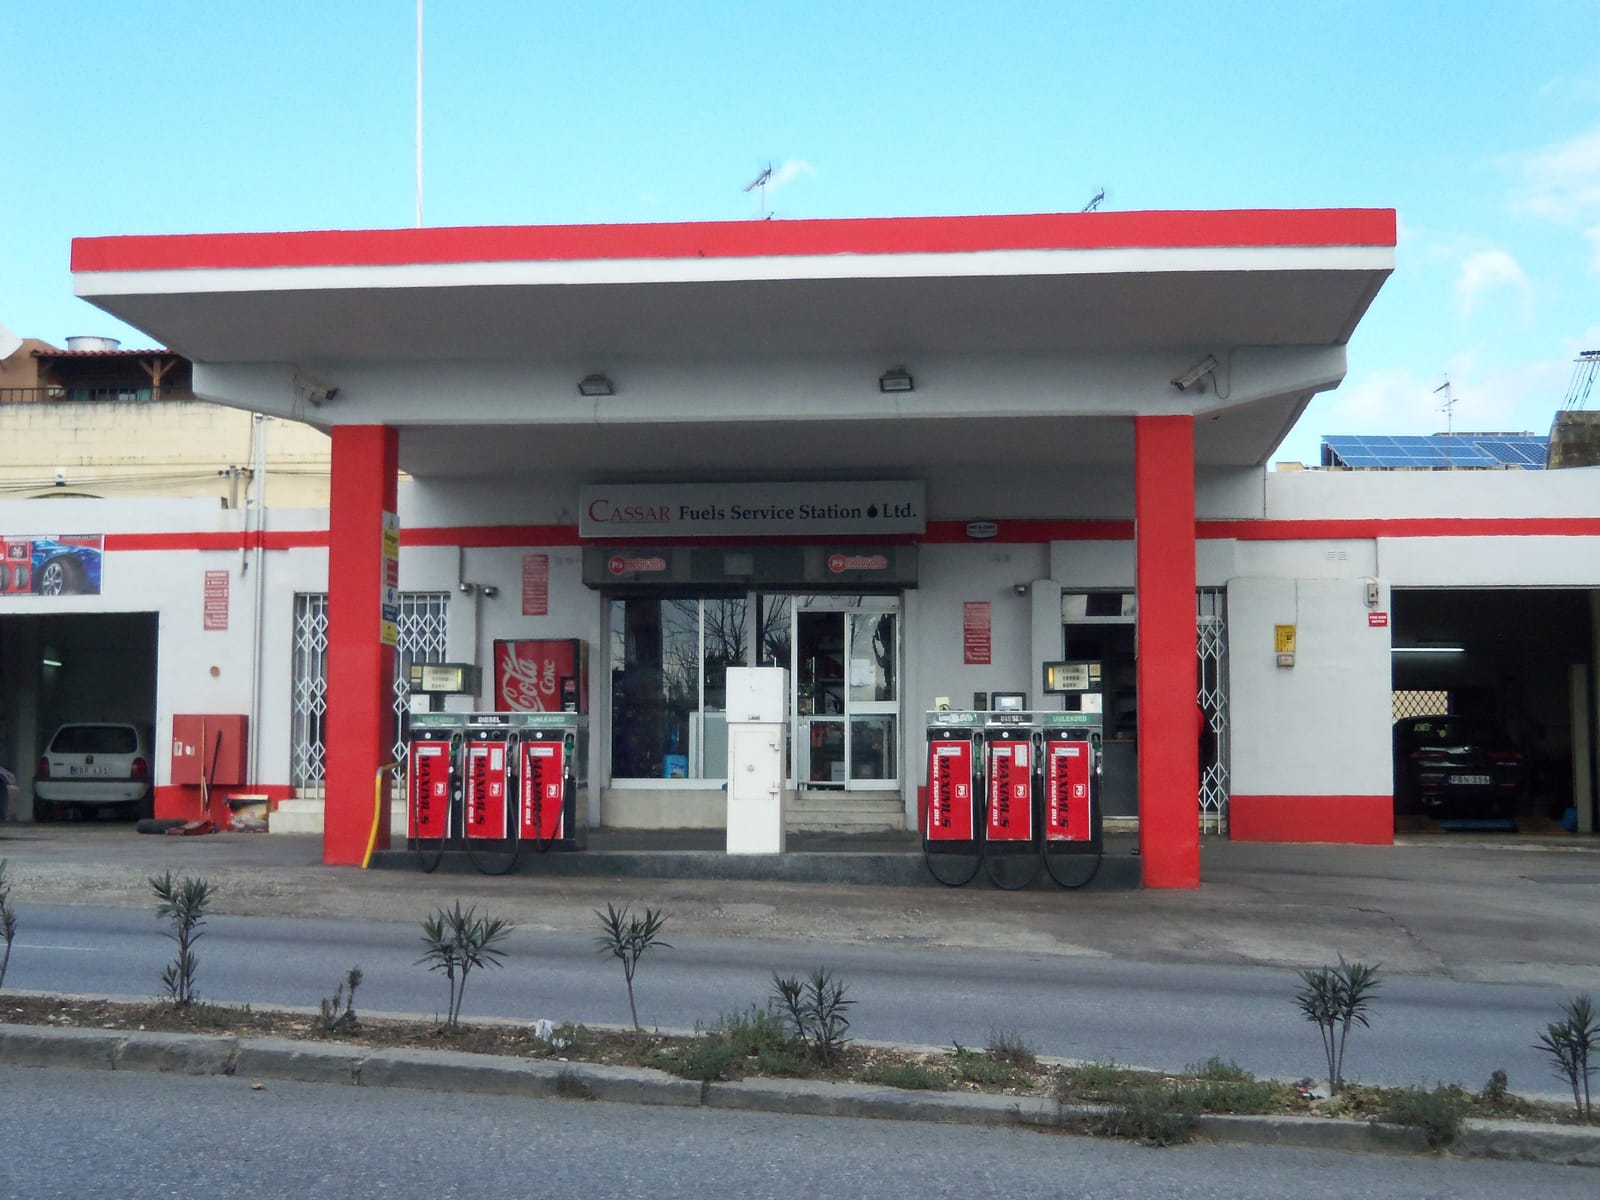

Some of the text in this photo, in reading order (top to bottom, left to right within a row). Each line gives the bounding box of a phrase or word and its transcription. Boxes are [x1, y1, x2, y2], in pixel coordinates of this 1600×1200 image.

[588, 499, 917, 523] CASSAR Fuels Service Station Ltd.
